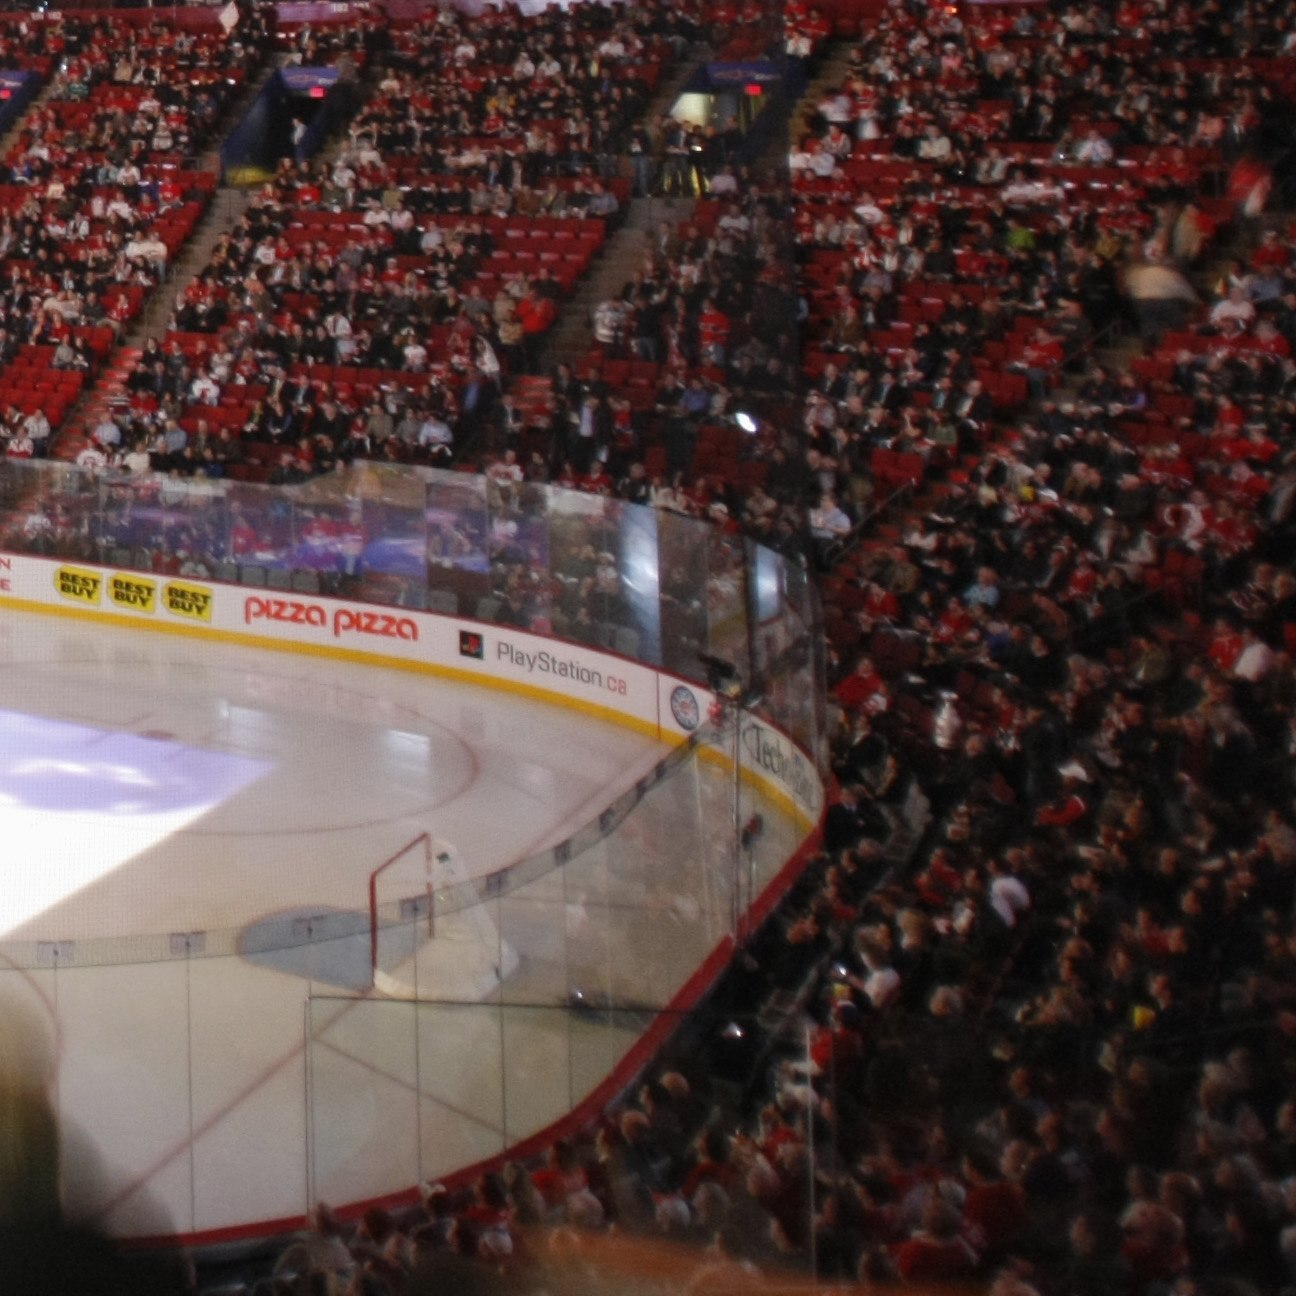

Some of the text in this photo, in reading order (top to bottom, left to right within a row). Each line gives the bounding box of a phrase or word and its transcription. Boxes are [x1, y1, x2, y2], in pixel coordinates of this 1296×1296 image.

[59, 570, 100, 590] BEST
[112, 576, 154, 596] BEST
[59, 582, 95, 600] BUY
[112, 588, 148, 607] BUY
[167, 585, 211, 604] BEST
[167, 597, 207, 615] BUY
[497, 641, 628, 696] PlayStation.ca
